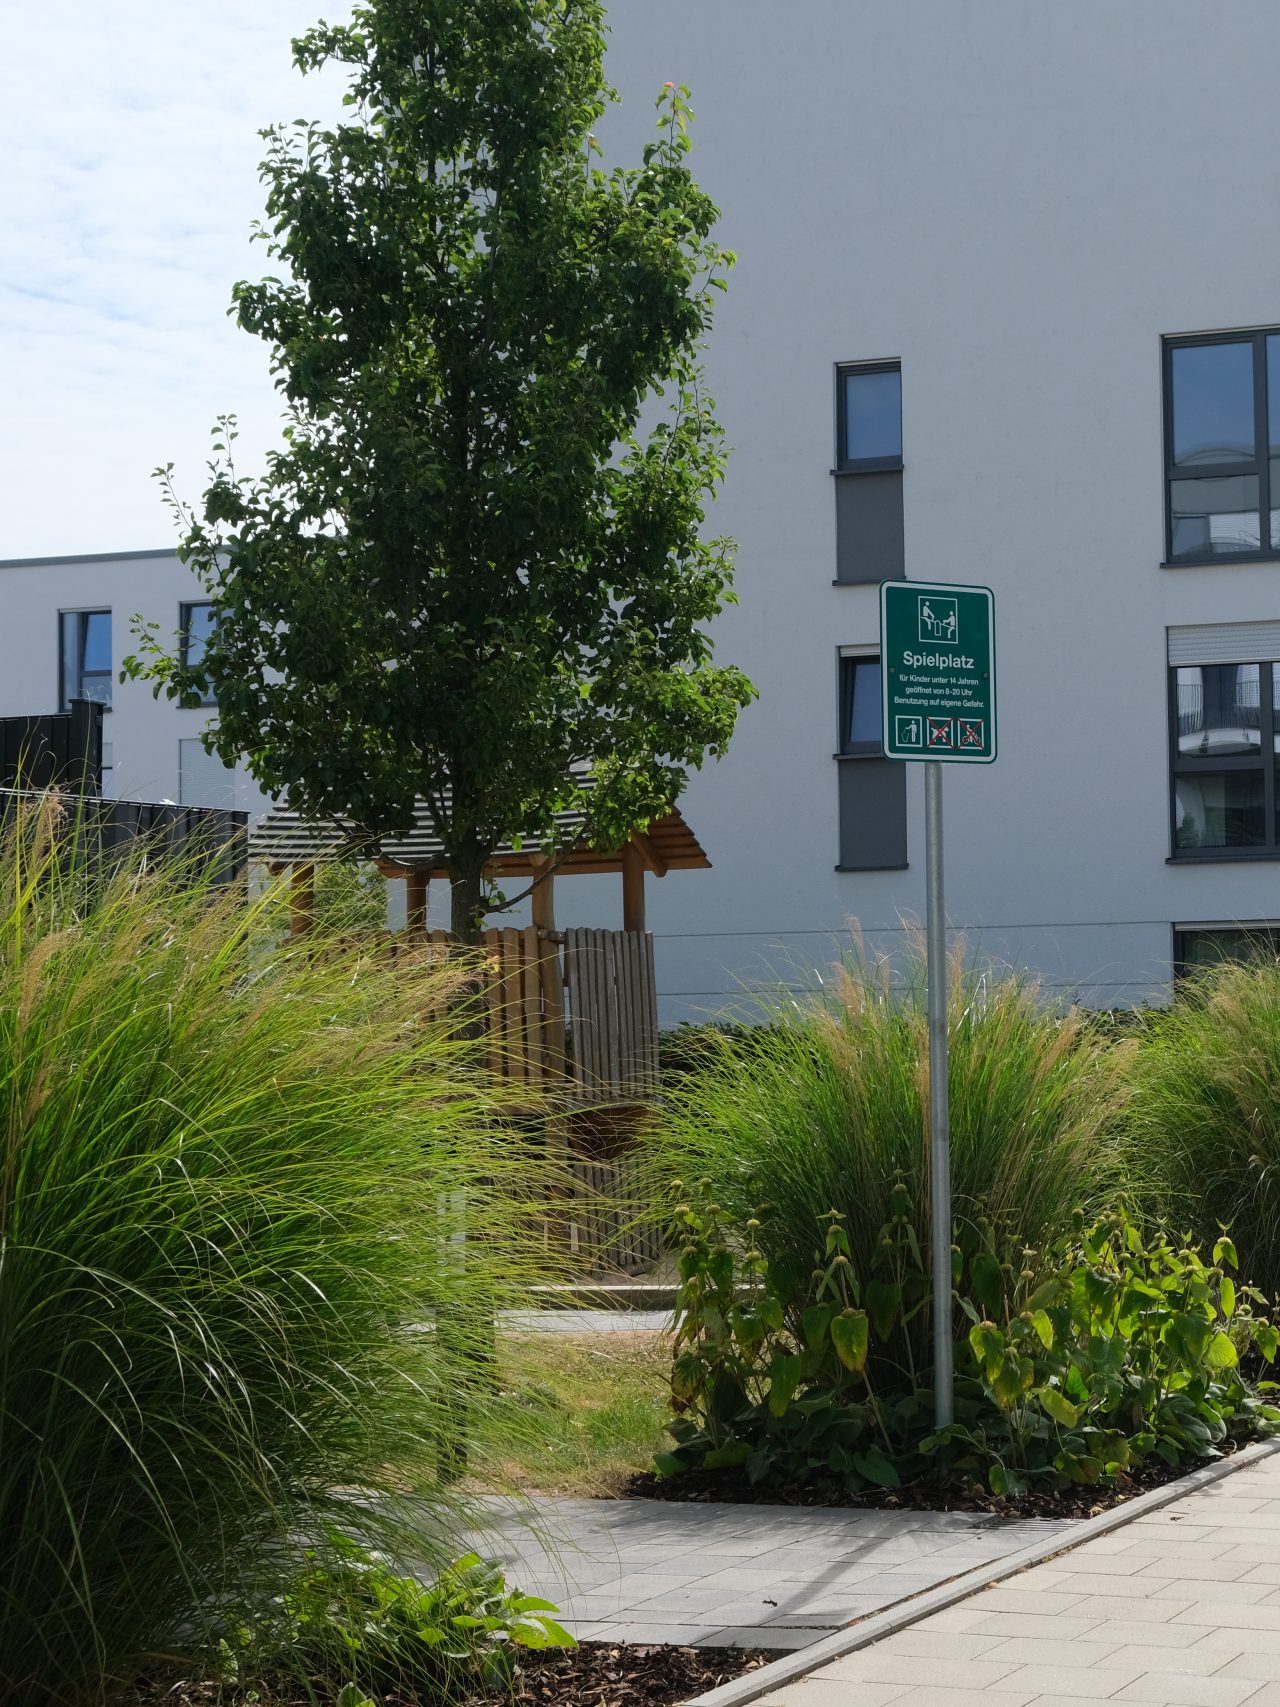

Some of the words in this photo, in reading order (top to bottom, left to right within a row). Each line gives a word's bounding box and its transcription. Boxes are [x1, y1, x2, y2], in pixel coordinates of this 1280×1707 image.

[903, 650, 975, 670] Spielplatz
[899, 674, 908, 682] für
[909, 674, 931, 683] Kinder
[931, 676, 948, 684] unter
[957, 677, 979, 686] Jahren
[905, 686, 932, 695] geöffnet
[961, 688, 973, 696] Uhr
[894, 696, 928, 707] Benutzung
[929, 698, 940, 706] auf
[940, 699, 962, 708] eigene
